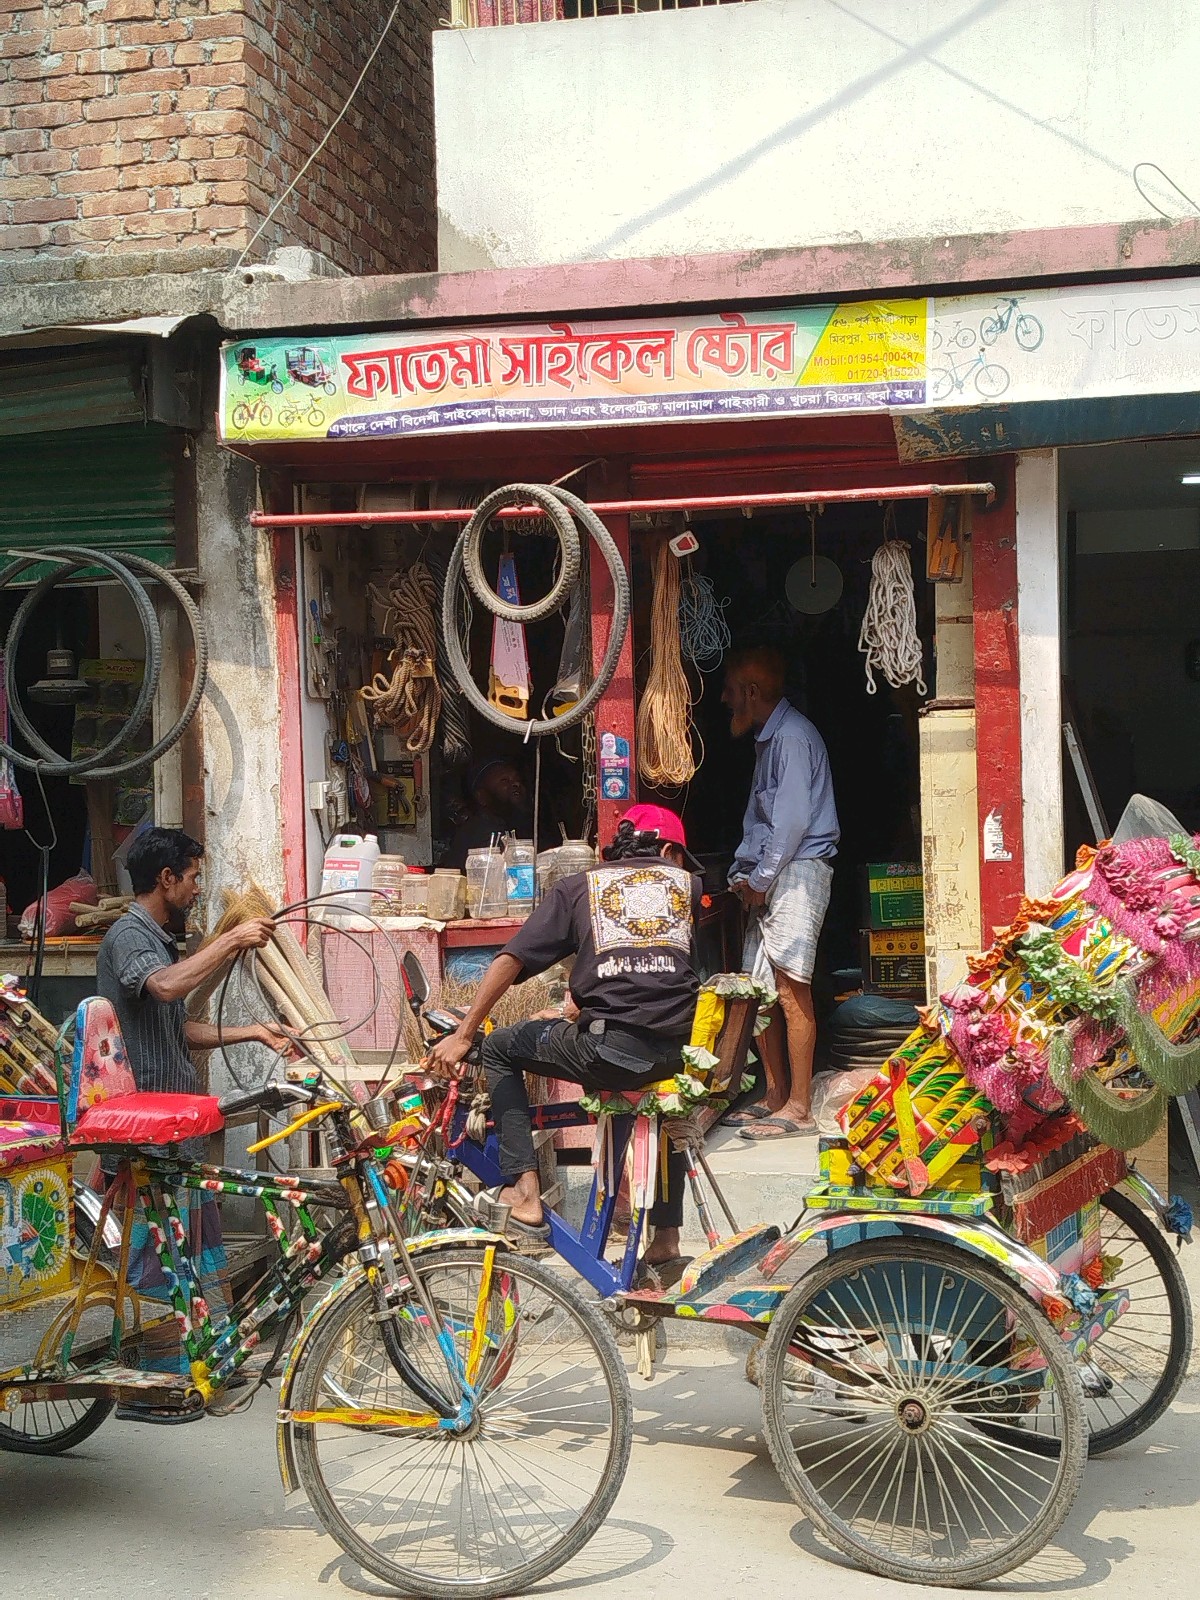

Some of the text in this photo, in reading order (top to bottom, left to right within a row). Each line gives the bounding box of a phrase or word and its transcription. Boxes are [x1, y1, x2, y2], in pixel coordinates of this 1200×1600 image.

[340, 312, 798, 400] ফাতেমা সাইকেল ষ্টোর
[329, 422, 366, 434] এখানে
[370, 417, 398, 430] দেশী
[401, 411, 441, 427] বিদেশী
[538, 406, 567, 417] ভ্যান
[571, 405, 598, 416] এবং
[662, 399, 714, 412] মালামাল
[717, 394, 769, 409] পাইকারী
[774, 395, 786, 406] ও
[790, 393, 821, 407] খুচরা
[865, 389, 891, 402] করা
